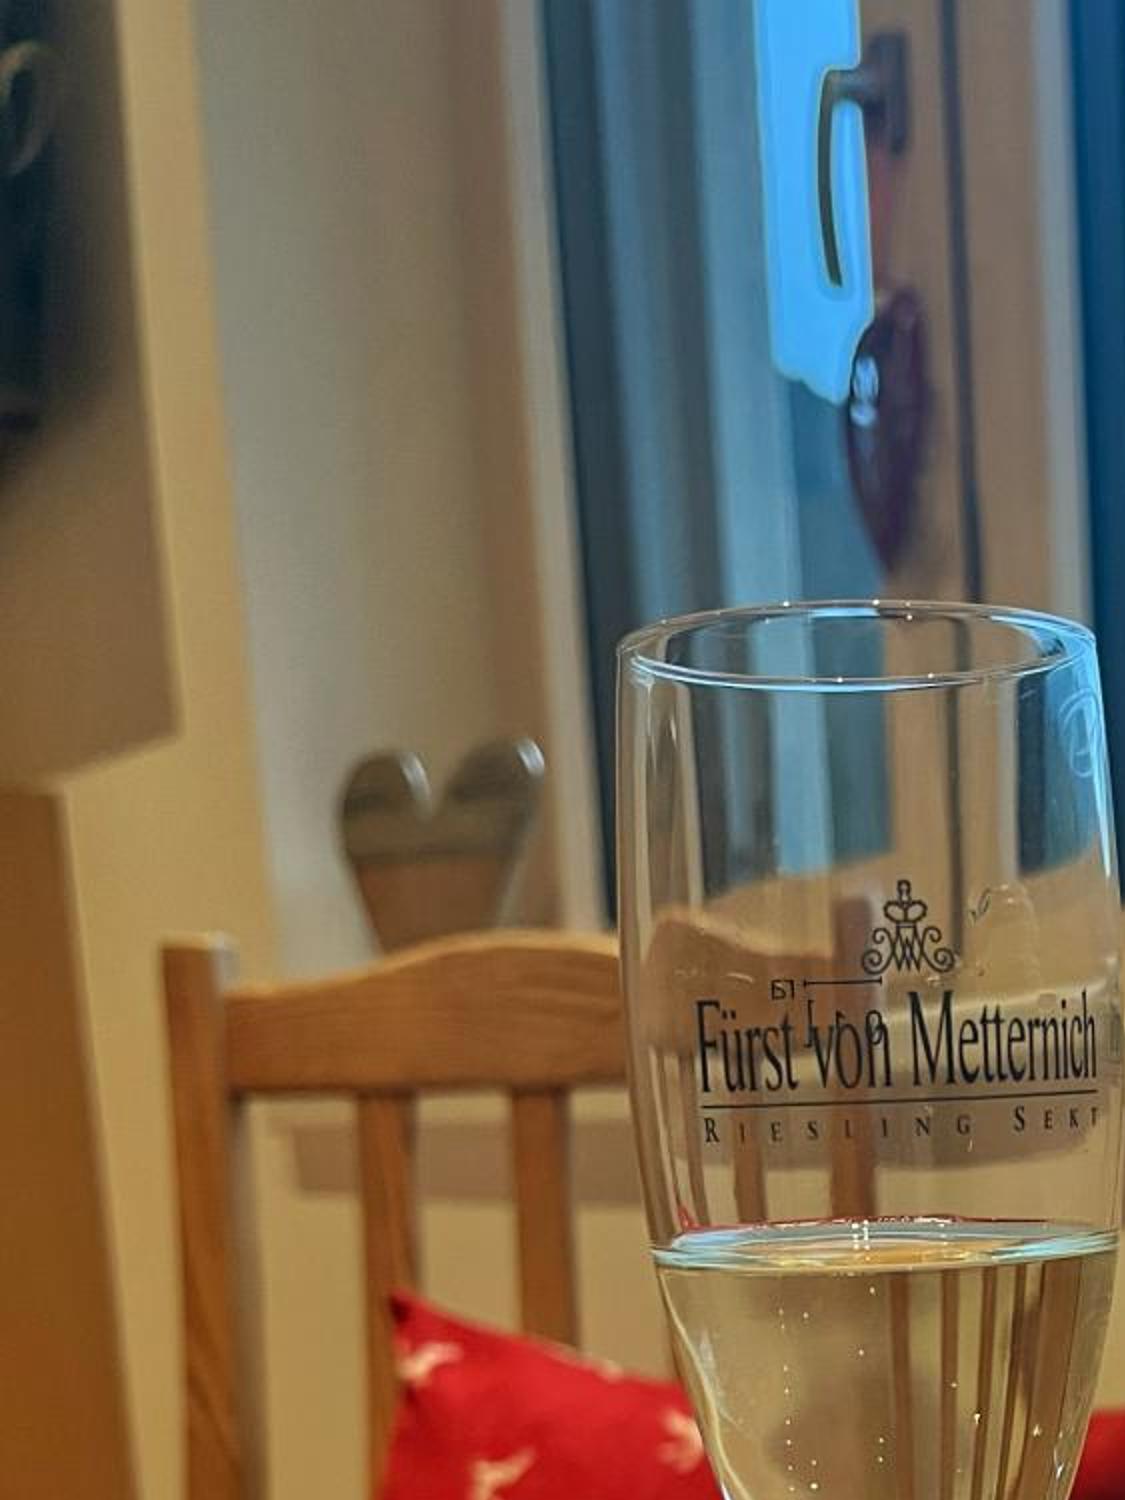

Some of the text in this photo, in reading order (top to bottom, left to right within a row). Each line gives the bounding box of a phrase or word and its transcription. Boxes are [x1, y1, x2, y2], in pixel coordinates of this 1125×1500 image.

[697, 988, 1098, 1093] Fürst von Metternich
[704, 1104, 1098, 1144] RIESLING SEKT
